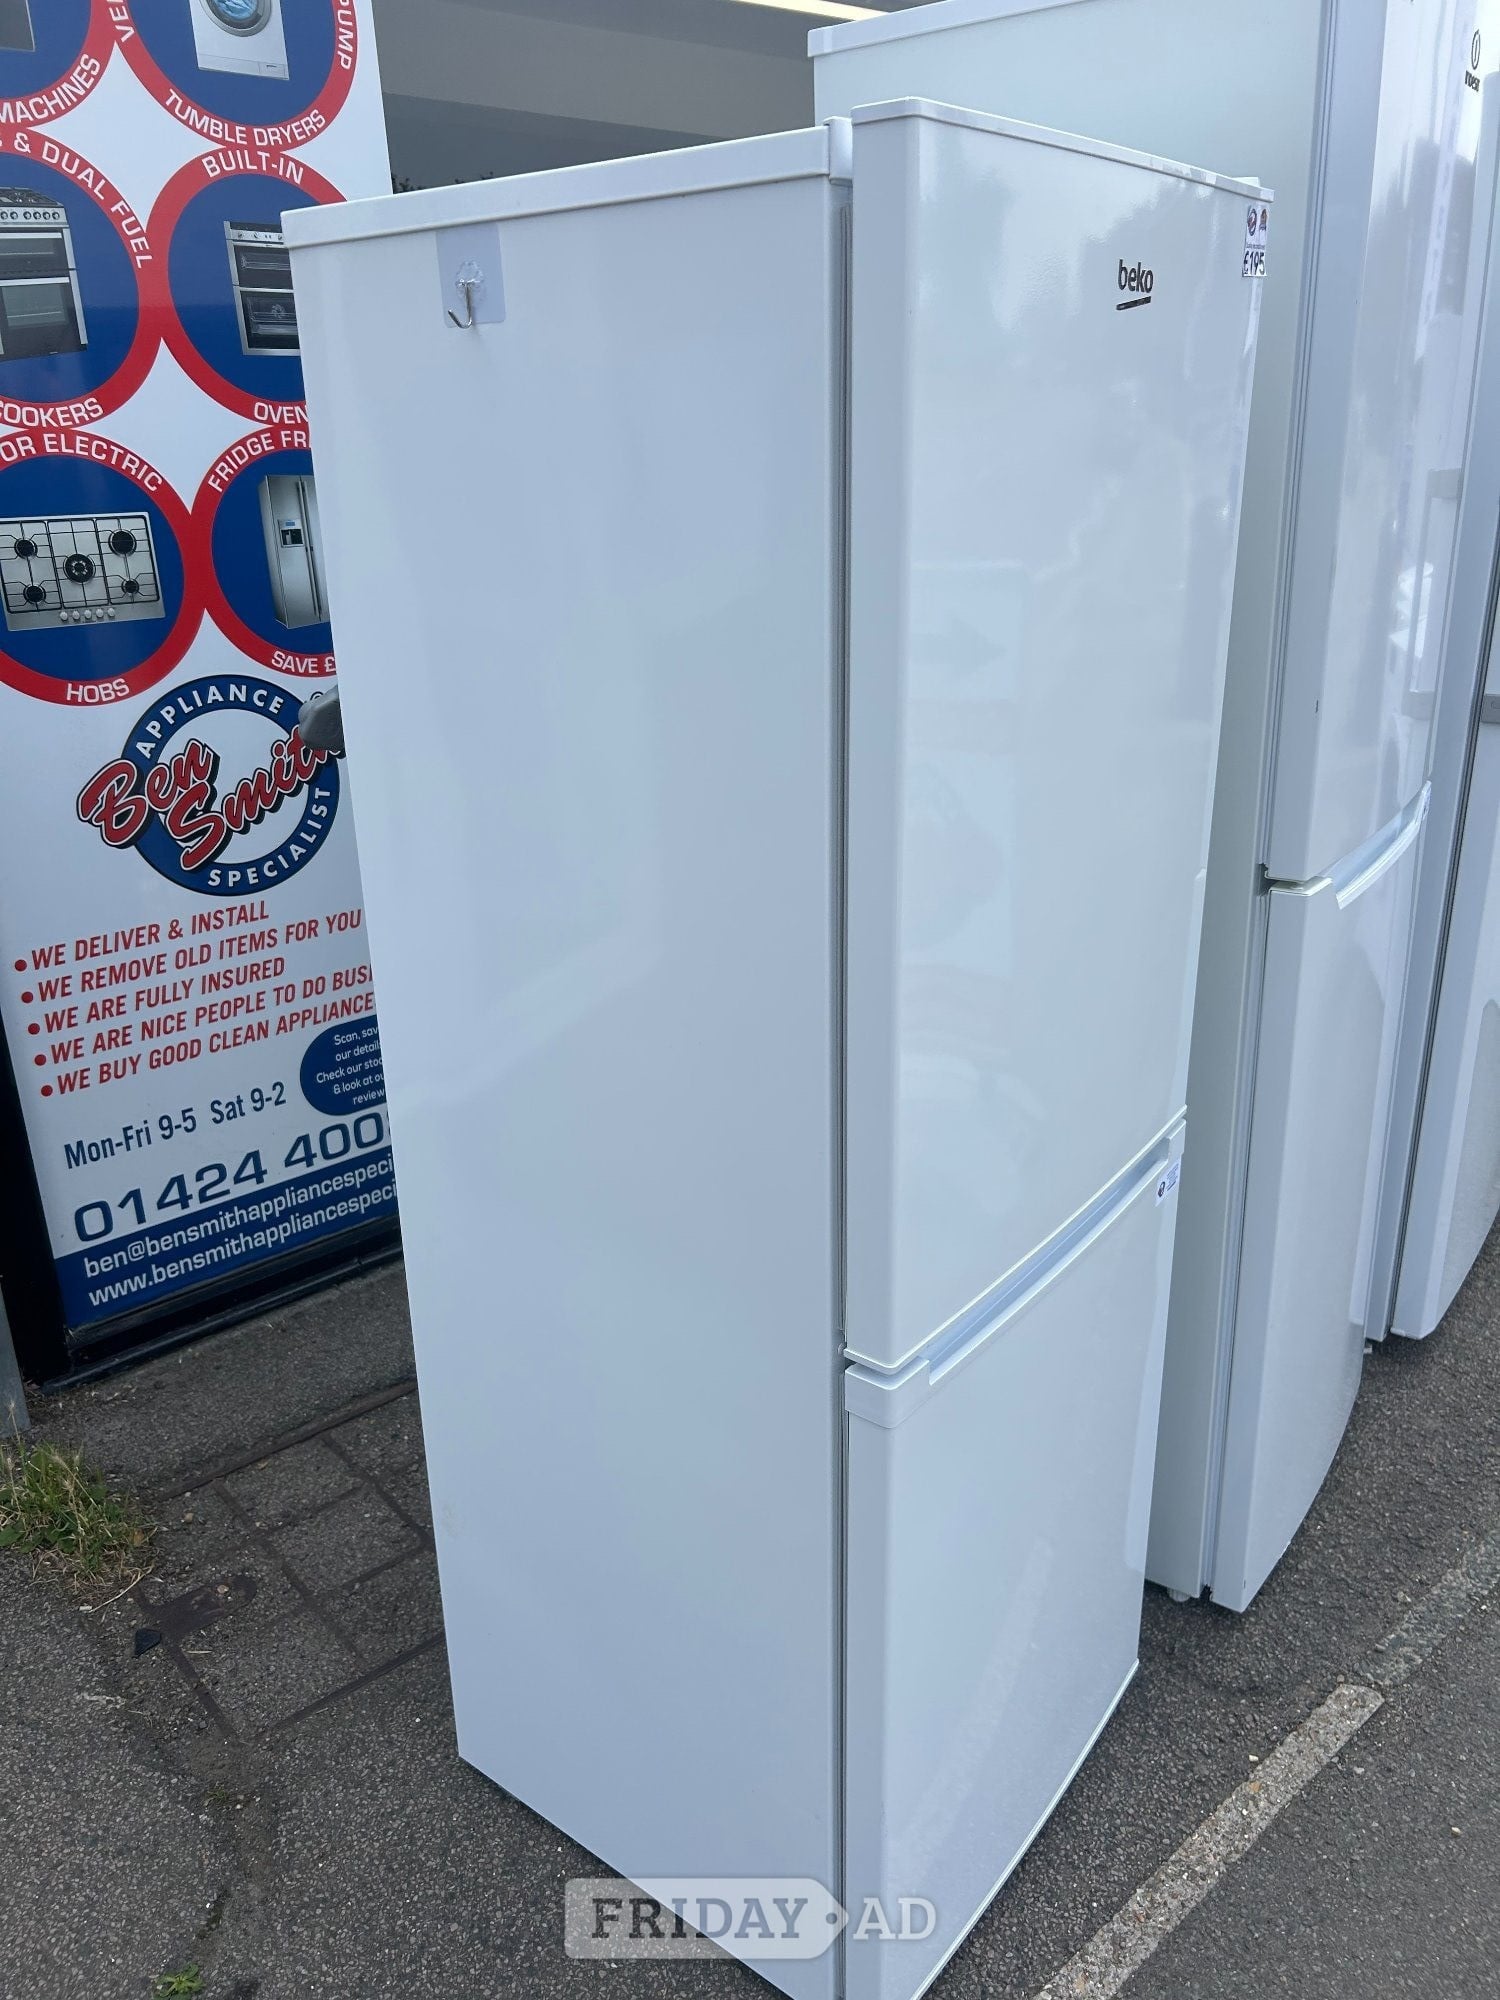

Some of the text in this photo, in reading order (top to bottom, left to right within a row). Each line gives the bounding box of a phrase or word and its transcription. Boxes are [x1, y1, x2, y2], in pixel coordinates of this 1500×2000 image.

[106, 0, 134, 42] VE
[0, 53, 101, 123] MACHINES
[165, 88, 325, 146] TUMBLE DRYERS
[202, 149, 304, 185] BUILT-IN
[13, 132, 152, 268] & DUAL FUEL
[1118, 258, 1154, 293] beko
[1243, 250, 1265, 276] £195
[0, 397, 104, 428] OOKERS
[0, 433, 163, 492] OR ELECTRIC
[207, 430, 311, 493] FRIDGE FR
[66, 678, 130, 703] HOBS
[271, 650, 319, 674] SAVE
[135, 683, 284, 759] APPLIANCE
[77, 739, 220, 849] Ben
[207, 787, 331, 888] SPECIALIST
[32, 900, 270, 970] WE DELIVER & INSTALL
[38, 908, 362, 1002] WE REMOVE OLD ITEMS FOR YOU
[44, 957, 285, 1033] WE ARE FULLY INSURED
[51, 1037, 85, 1064] WE
[92, 1024, 133, 1055] ARE
[141, 1011, 187, 1041] NICE
[195, 990, 266, 1027] PEOPLE
[273, 983, 296, 1006] TO
[303, 976, 326, 999] DO
[57, 991, 375, 1095] WE BUY GOOD CLEAN APPLIANCE
[334, 1031, 361, 1046] Scan,
[335, 1049, 351, 1062] our
[316, 1067, 346, 1084] Check
[346, 1062, 362, 1075] our
[333, 1083, 342, 1095] &
[342, 1078, 362, 1093] look
[363, 1074, 374, 1085] at
[64, 1080, 287, 1169] Mon-Fri 9-5 Sat 9-2
[74, 1112, 391, 1242] 01424 400
[84, 1152, 394, 1278] ben@bensmithappliancespeci
